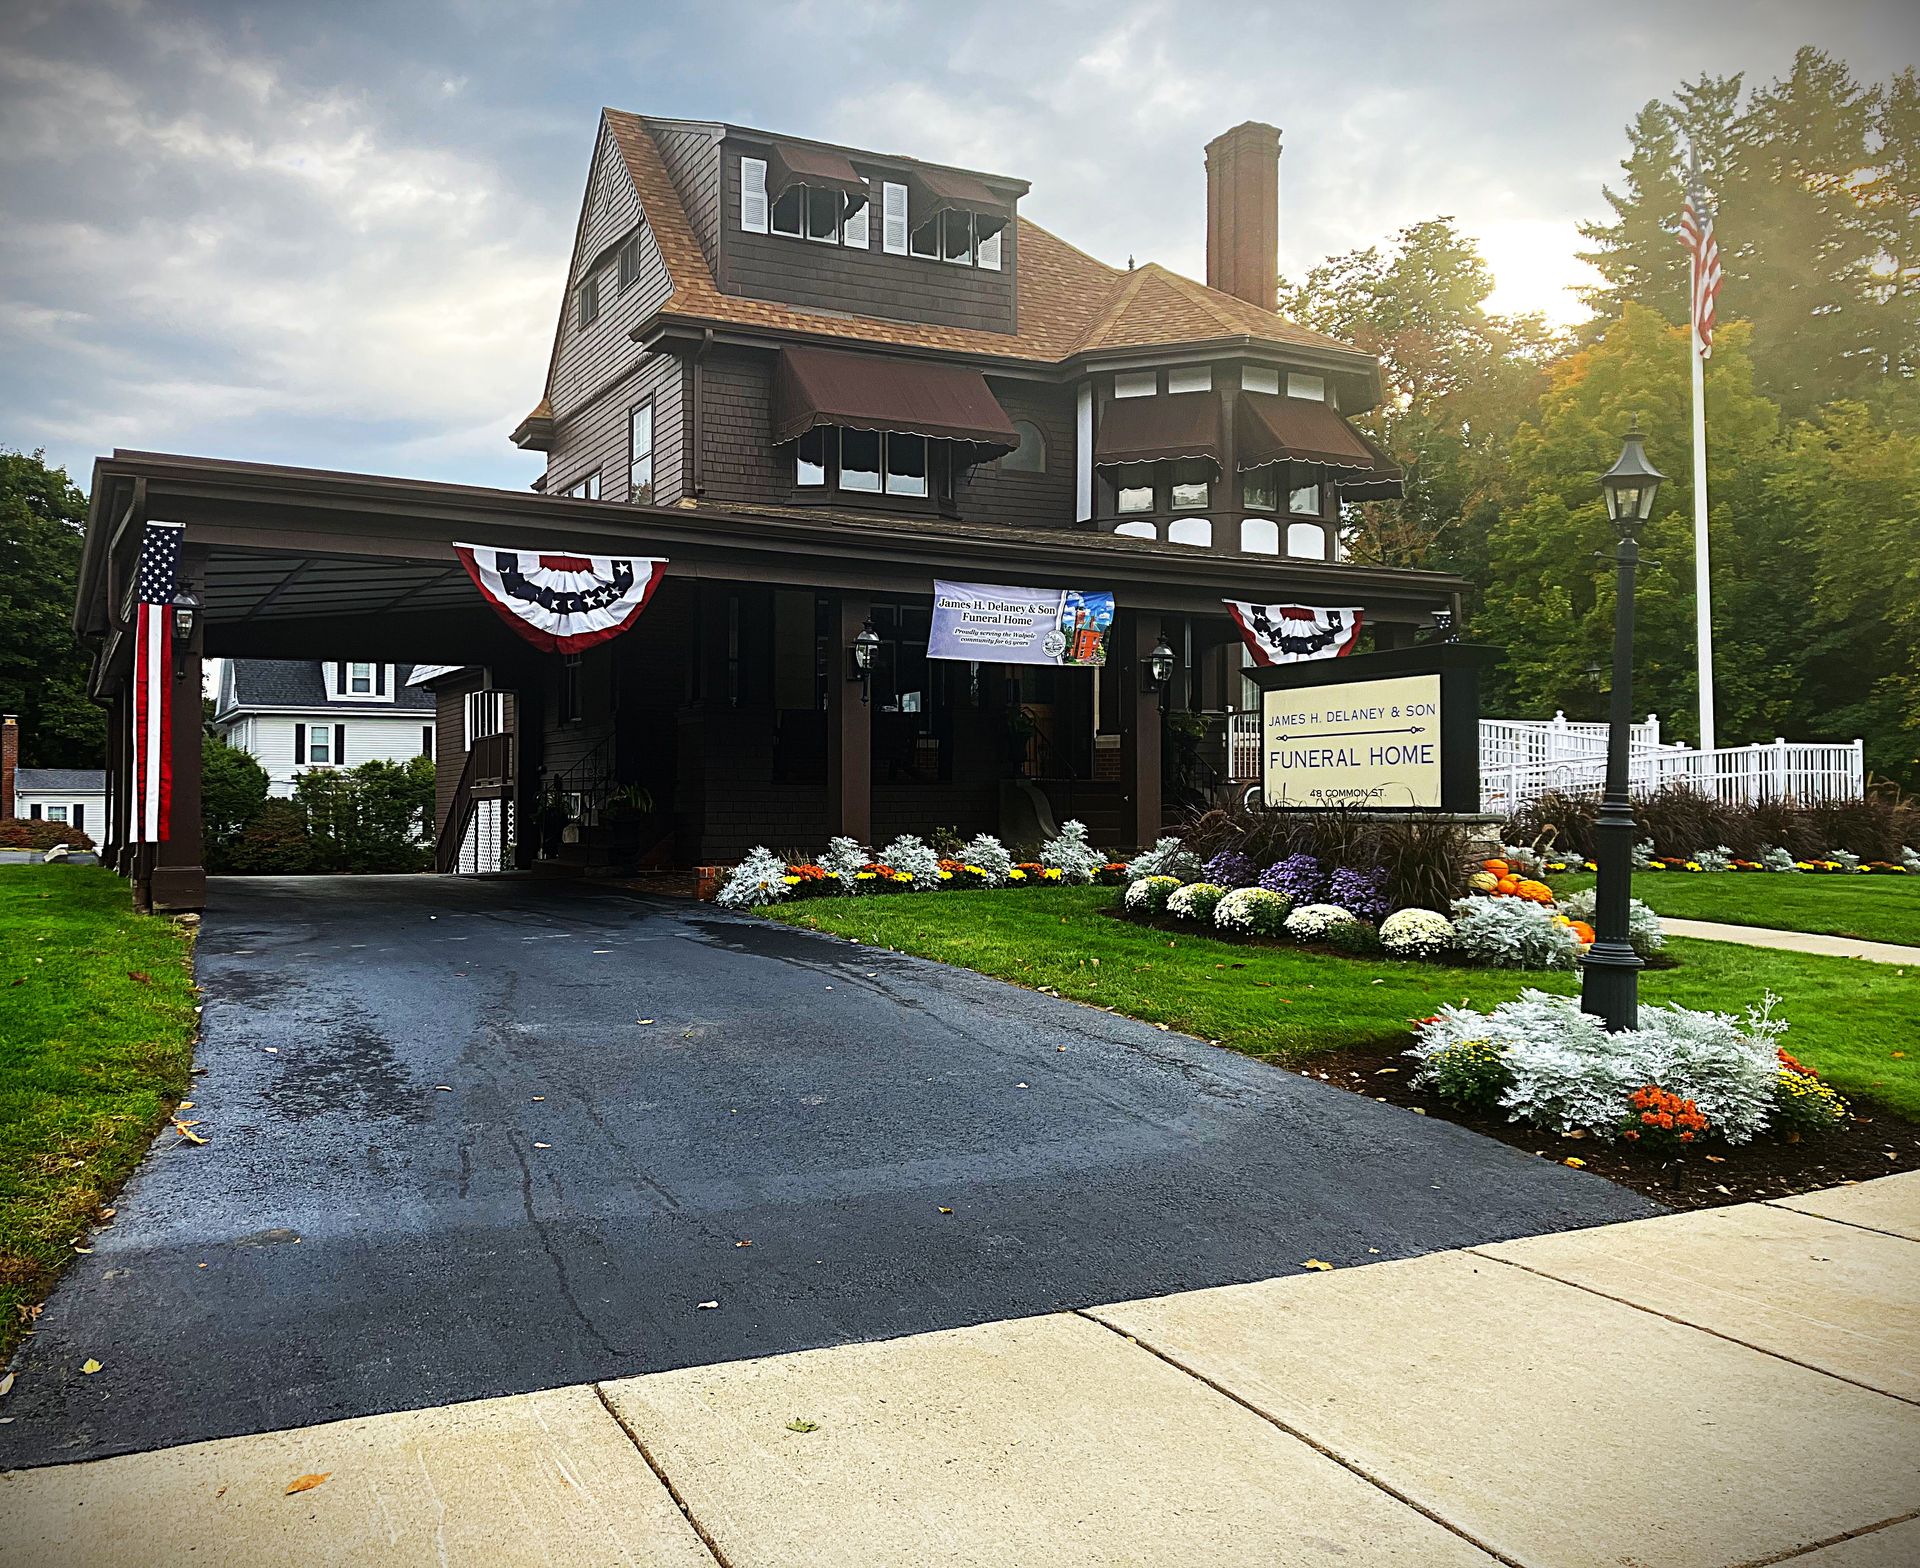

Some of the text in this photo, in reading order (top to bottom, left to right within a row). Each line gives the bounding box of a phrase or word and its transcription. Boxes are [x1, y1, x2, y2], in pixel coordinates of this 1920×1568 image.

[939, 598, 1056, 614] James H. Delaney & Son
[962, 612, 1032, 626] Funeral Home
[1268, 704, 1436, 726] JAMES H. DELANEY & SON
[1270, 744, 1434, 768] FUNERAL HOME
[1310, 788, 1387, 798] 48 COMMON ST.
